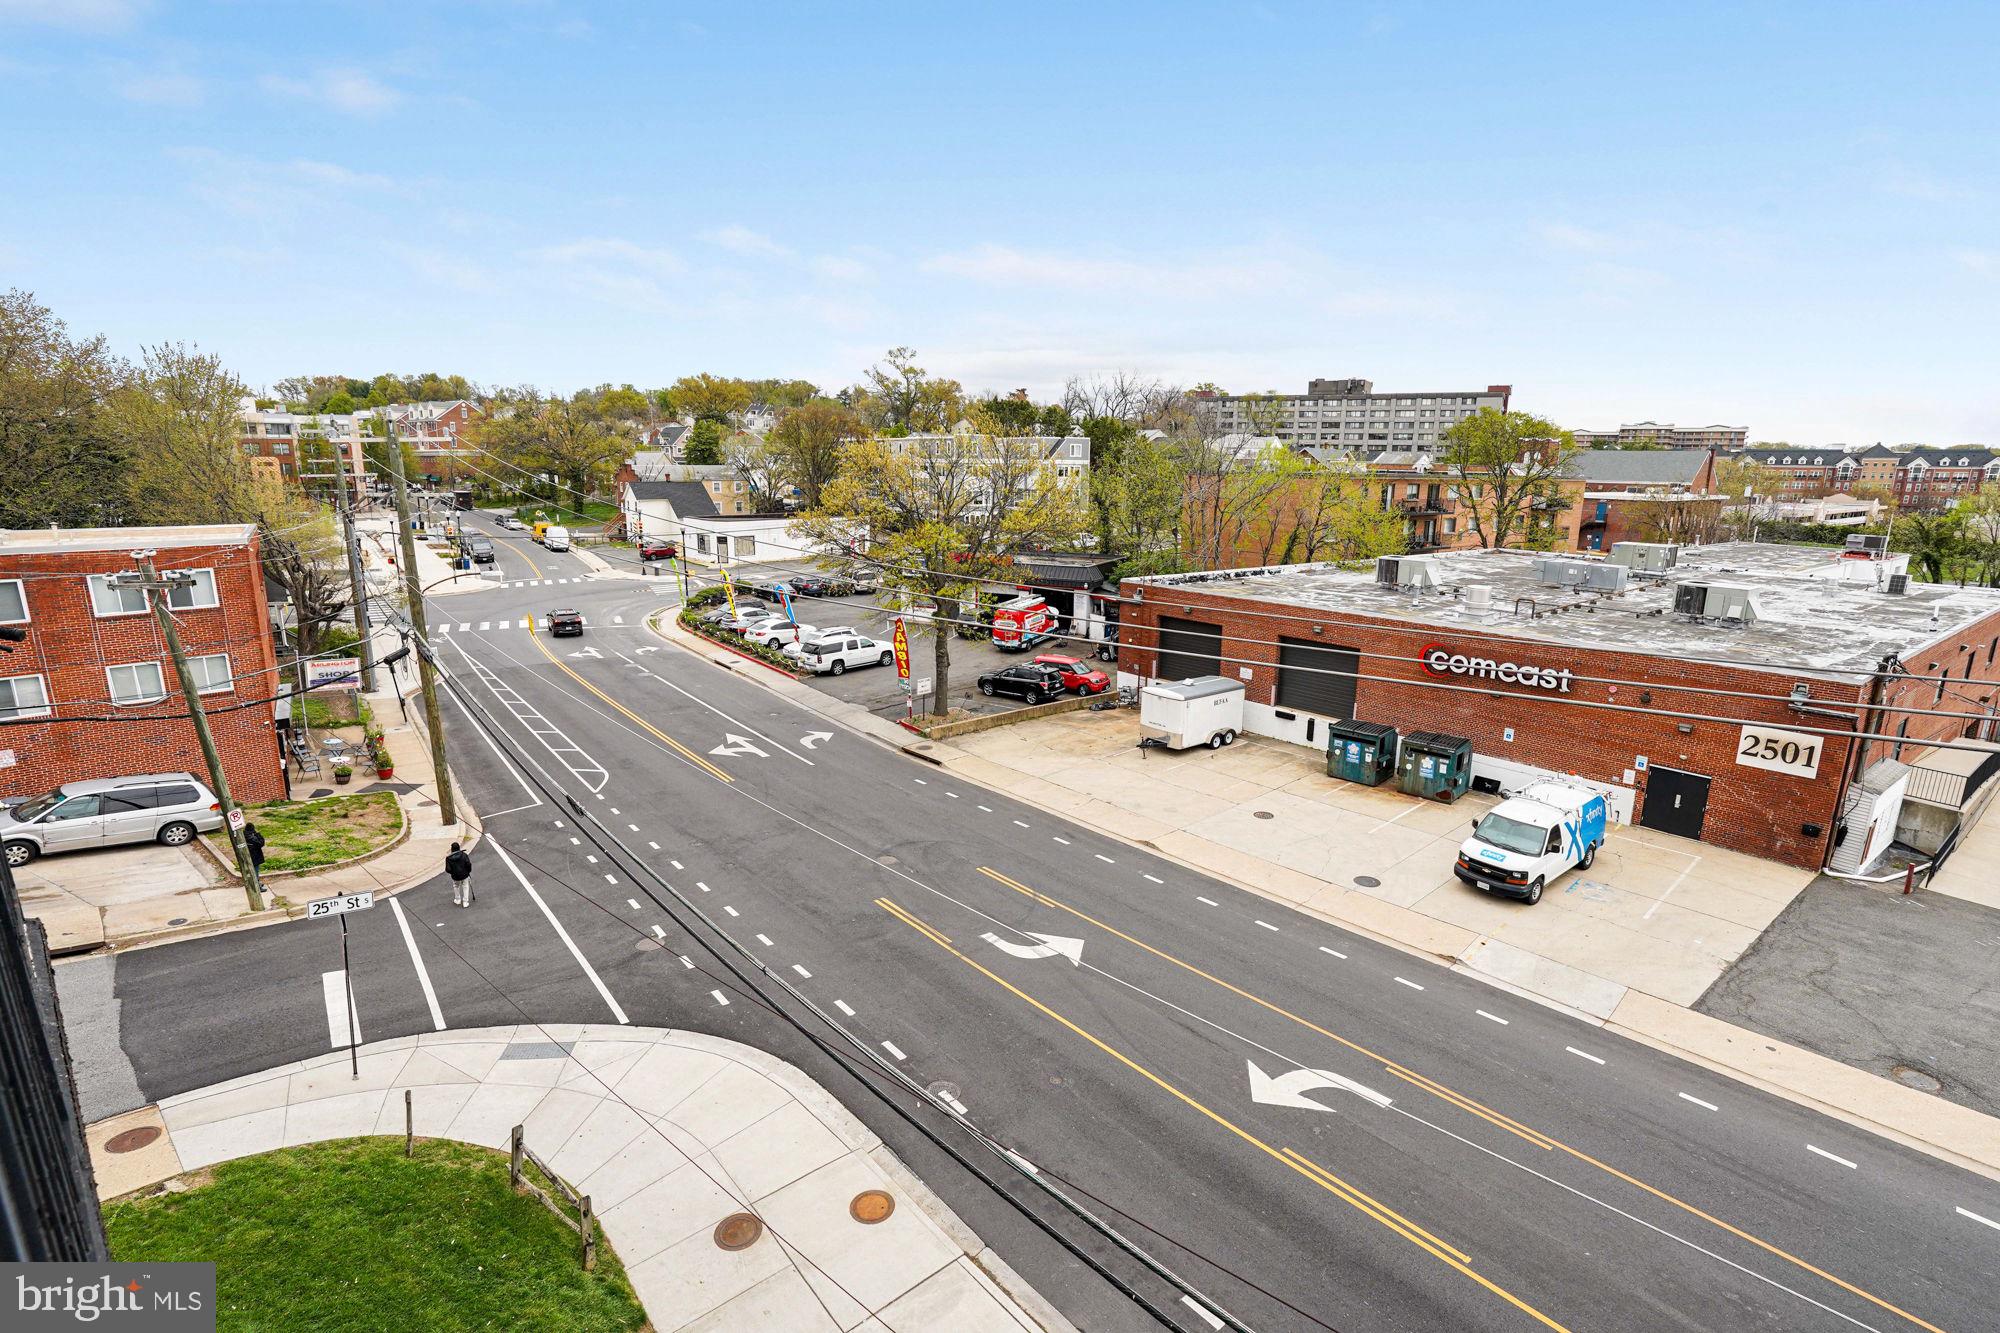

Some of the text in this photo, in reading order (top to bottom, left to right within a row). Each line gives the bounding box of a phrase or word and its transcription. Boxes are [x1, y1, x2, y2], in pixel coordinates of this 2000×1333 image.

[1430, 651, 1573, 692] comcast
[1740, 735, 1816, 769] 2501
[312, 900, 339, 916] 25th
[347, 896, 360, 909] St
